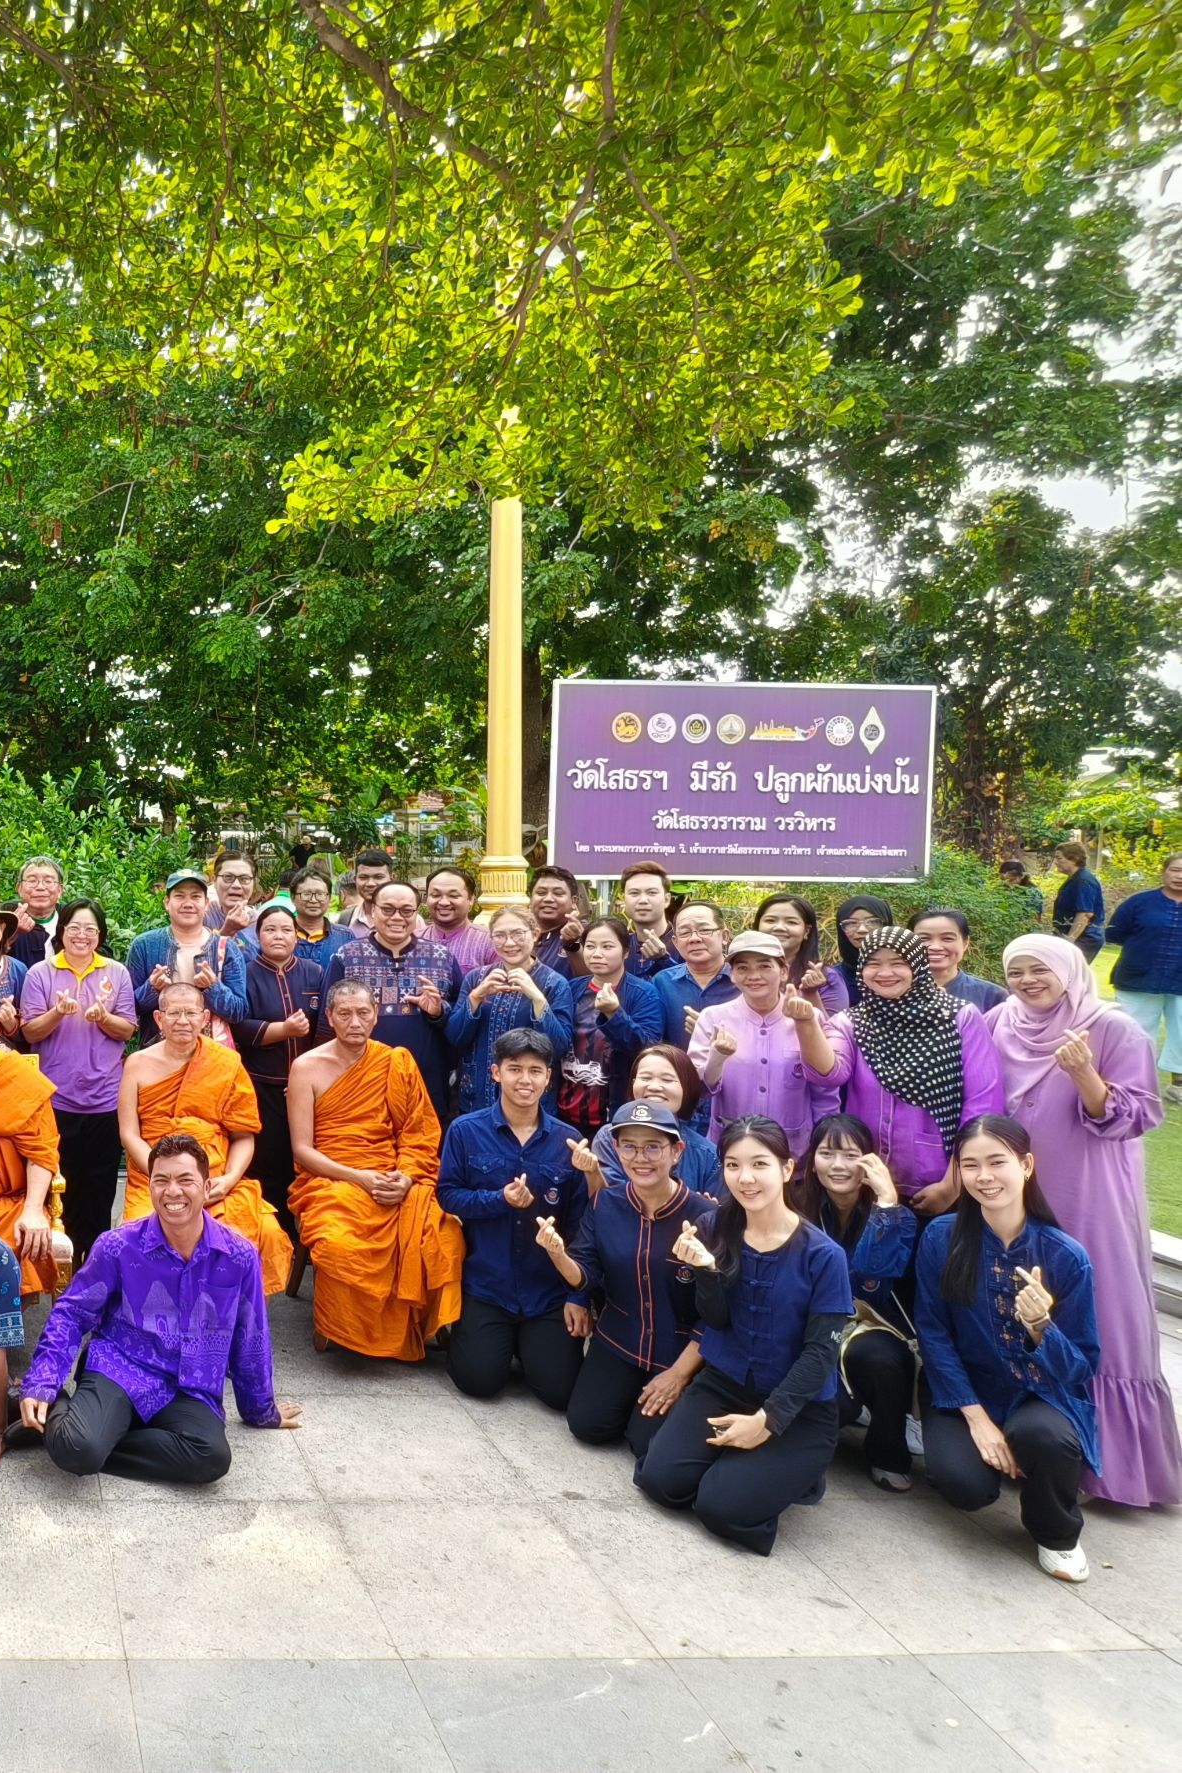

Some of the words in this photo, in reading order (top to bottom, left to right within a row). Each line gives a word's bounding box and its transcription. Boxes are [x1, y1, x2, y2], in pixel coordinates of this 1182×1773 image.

[566, 757, 669, 792] วัดโสธรฯ
[689, 760, 737, 793] มีรัก
[754, 756, 920, 804] ปลูกผักแบ่งปัน
[651, 807, 767, 832] วัดโสธรวราราม
[774, 810, 837, 832] วรวิหาร
